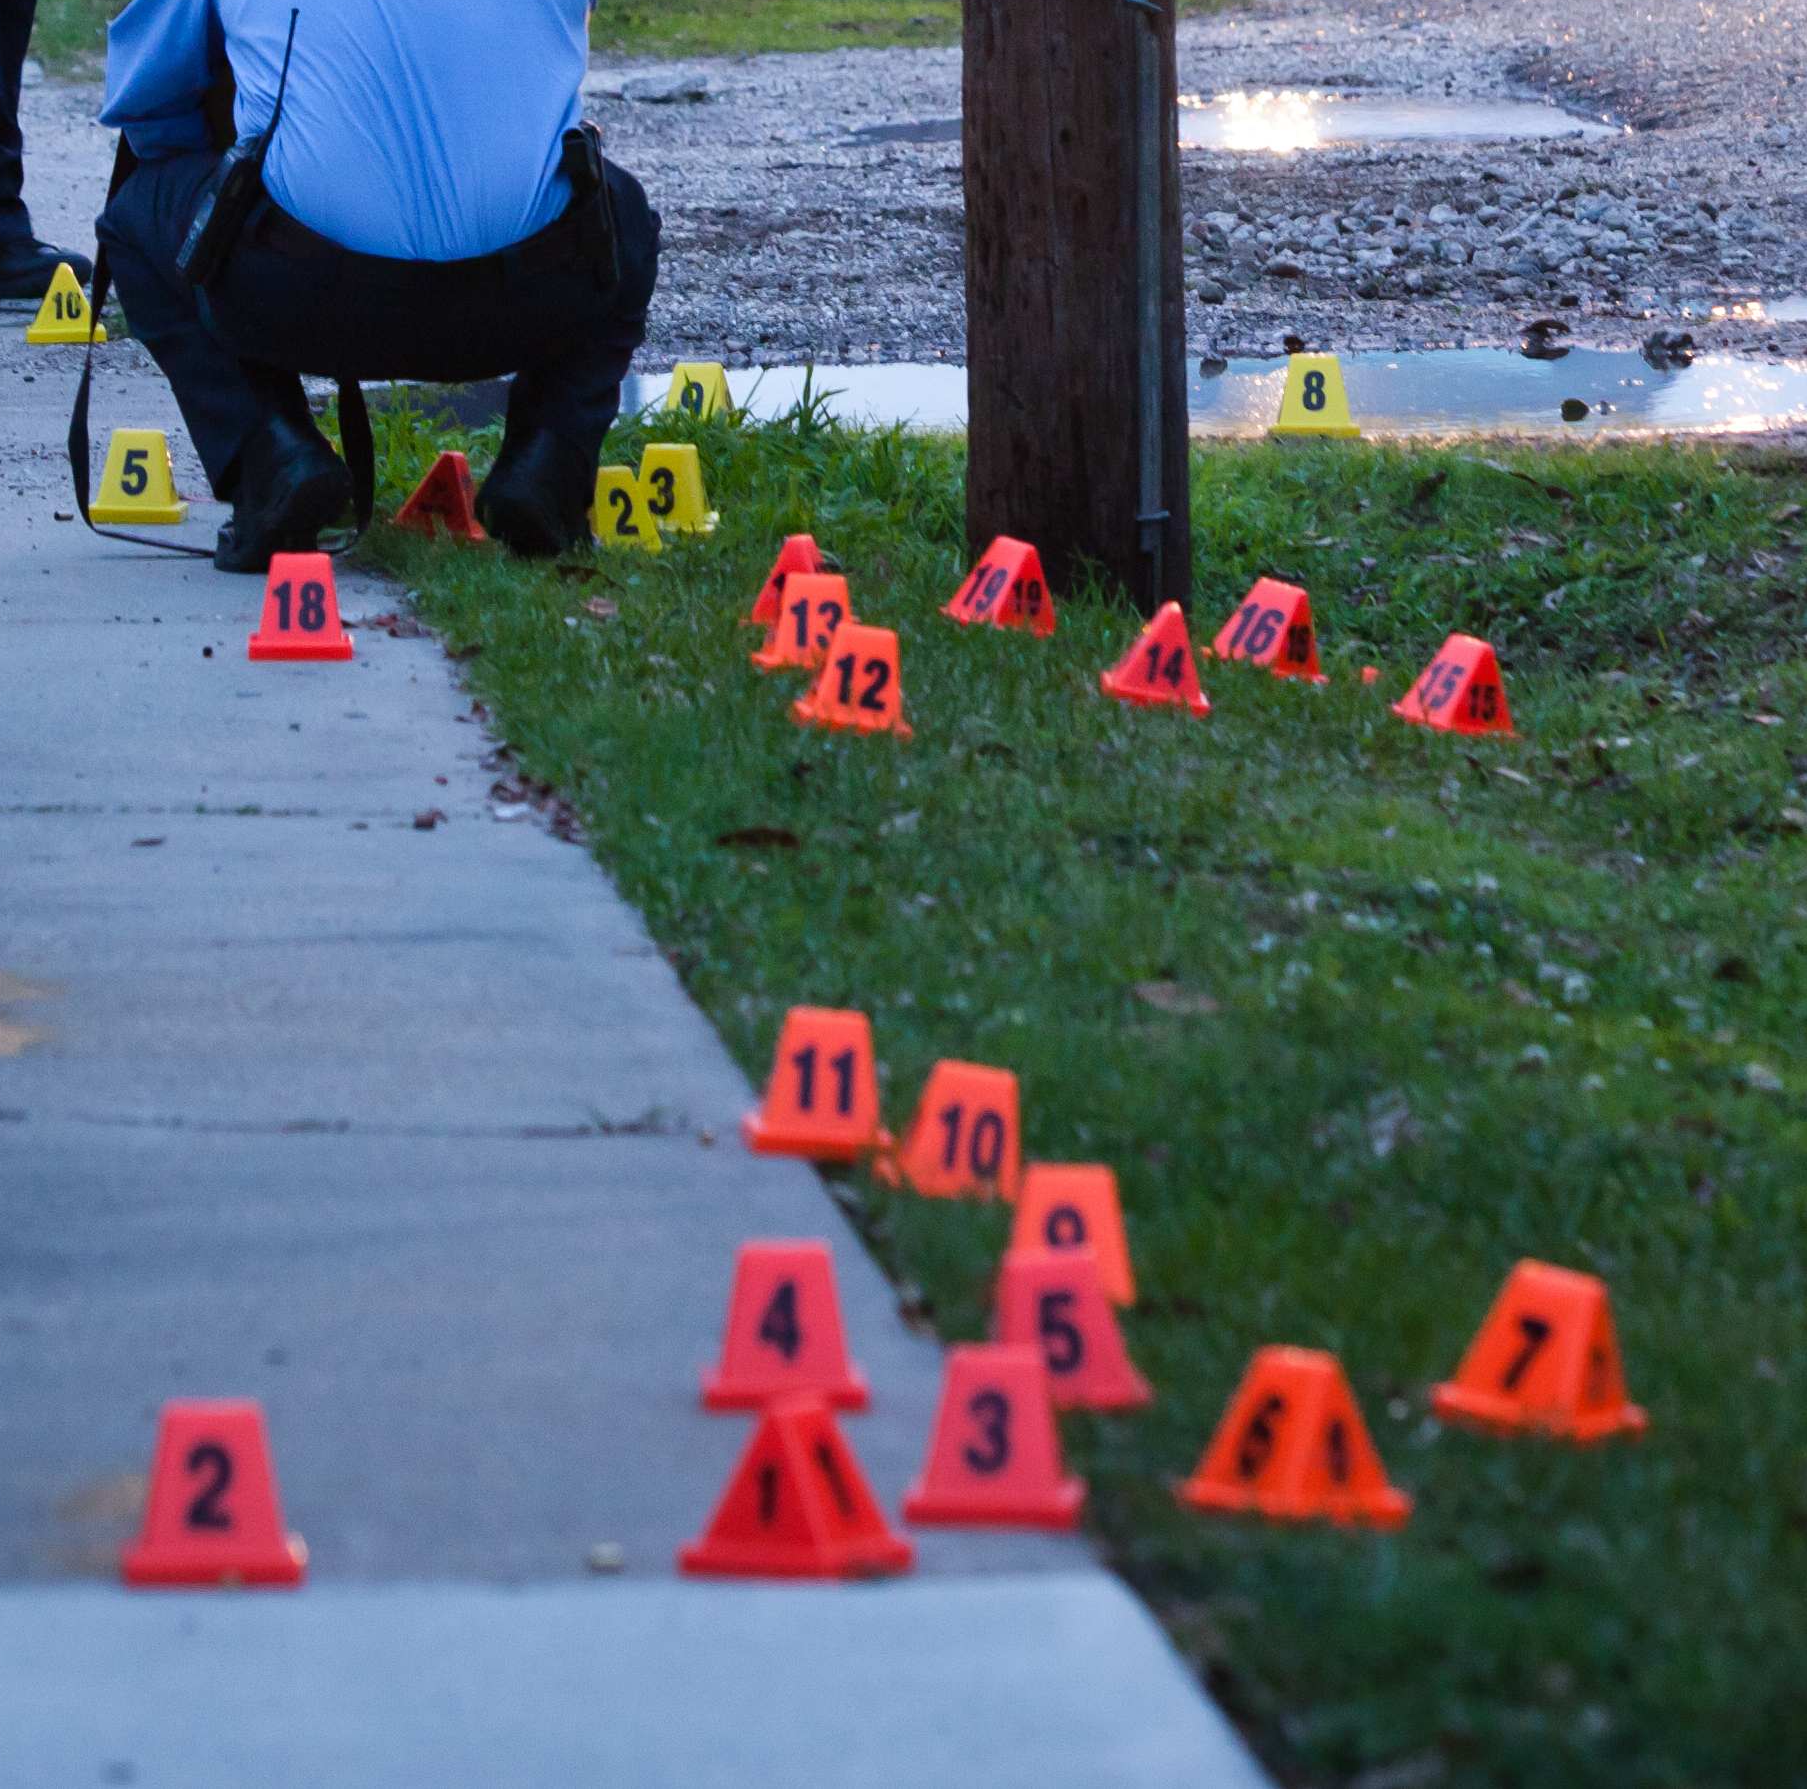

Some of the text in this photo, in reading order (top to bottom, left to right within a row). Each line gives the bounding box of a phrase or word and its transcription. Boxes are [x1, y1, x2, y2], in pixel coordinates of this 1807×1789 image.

[52, 292, 81, 321] 10
[1302, 369, 1326, 412] 8
[121, 449, 148, 496] 5
[648, 467, 676, 517] 3
[609, 487, 640, 536] 2
[273, 580, 326, 632] 18
[963, 563, 1008, 614] 19
[790, 598, 843, 649] 13
[1230, 602, 1285, 656] 16
[836, 652, 891, 712] 12
[1147, 644, 1184, 688] 14
[1419, 660, 1466, 711] 15
[792, 1044, 856, 1113] 11
[940, 1102, 1004, 1178] 10
[758, 1280, 801, 1361] 4
[1038, 1290, 1084, 1375] 5
[1505, 1315, 1550, 1392] 7
[963, 1388, 1011, 1473] 3
[185, 1438, 233, 1534] 2
